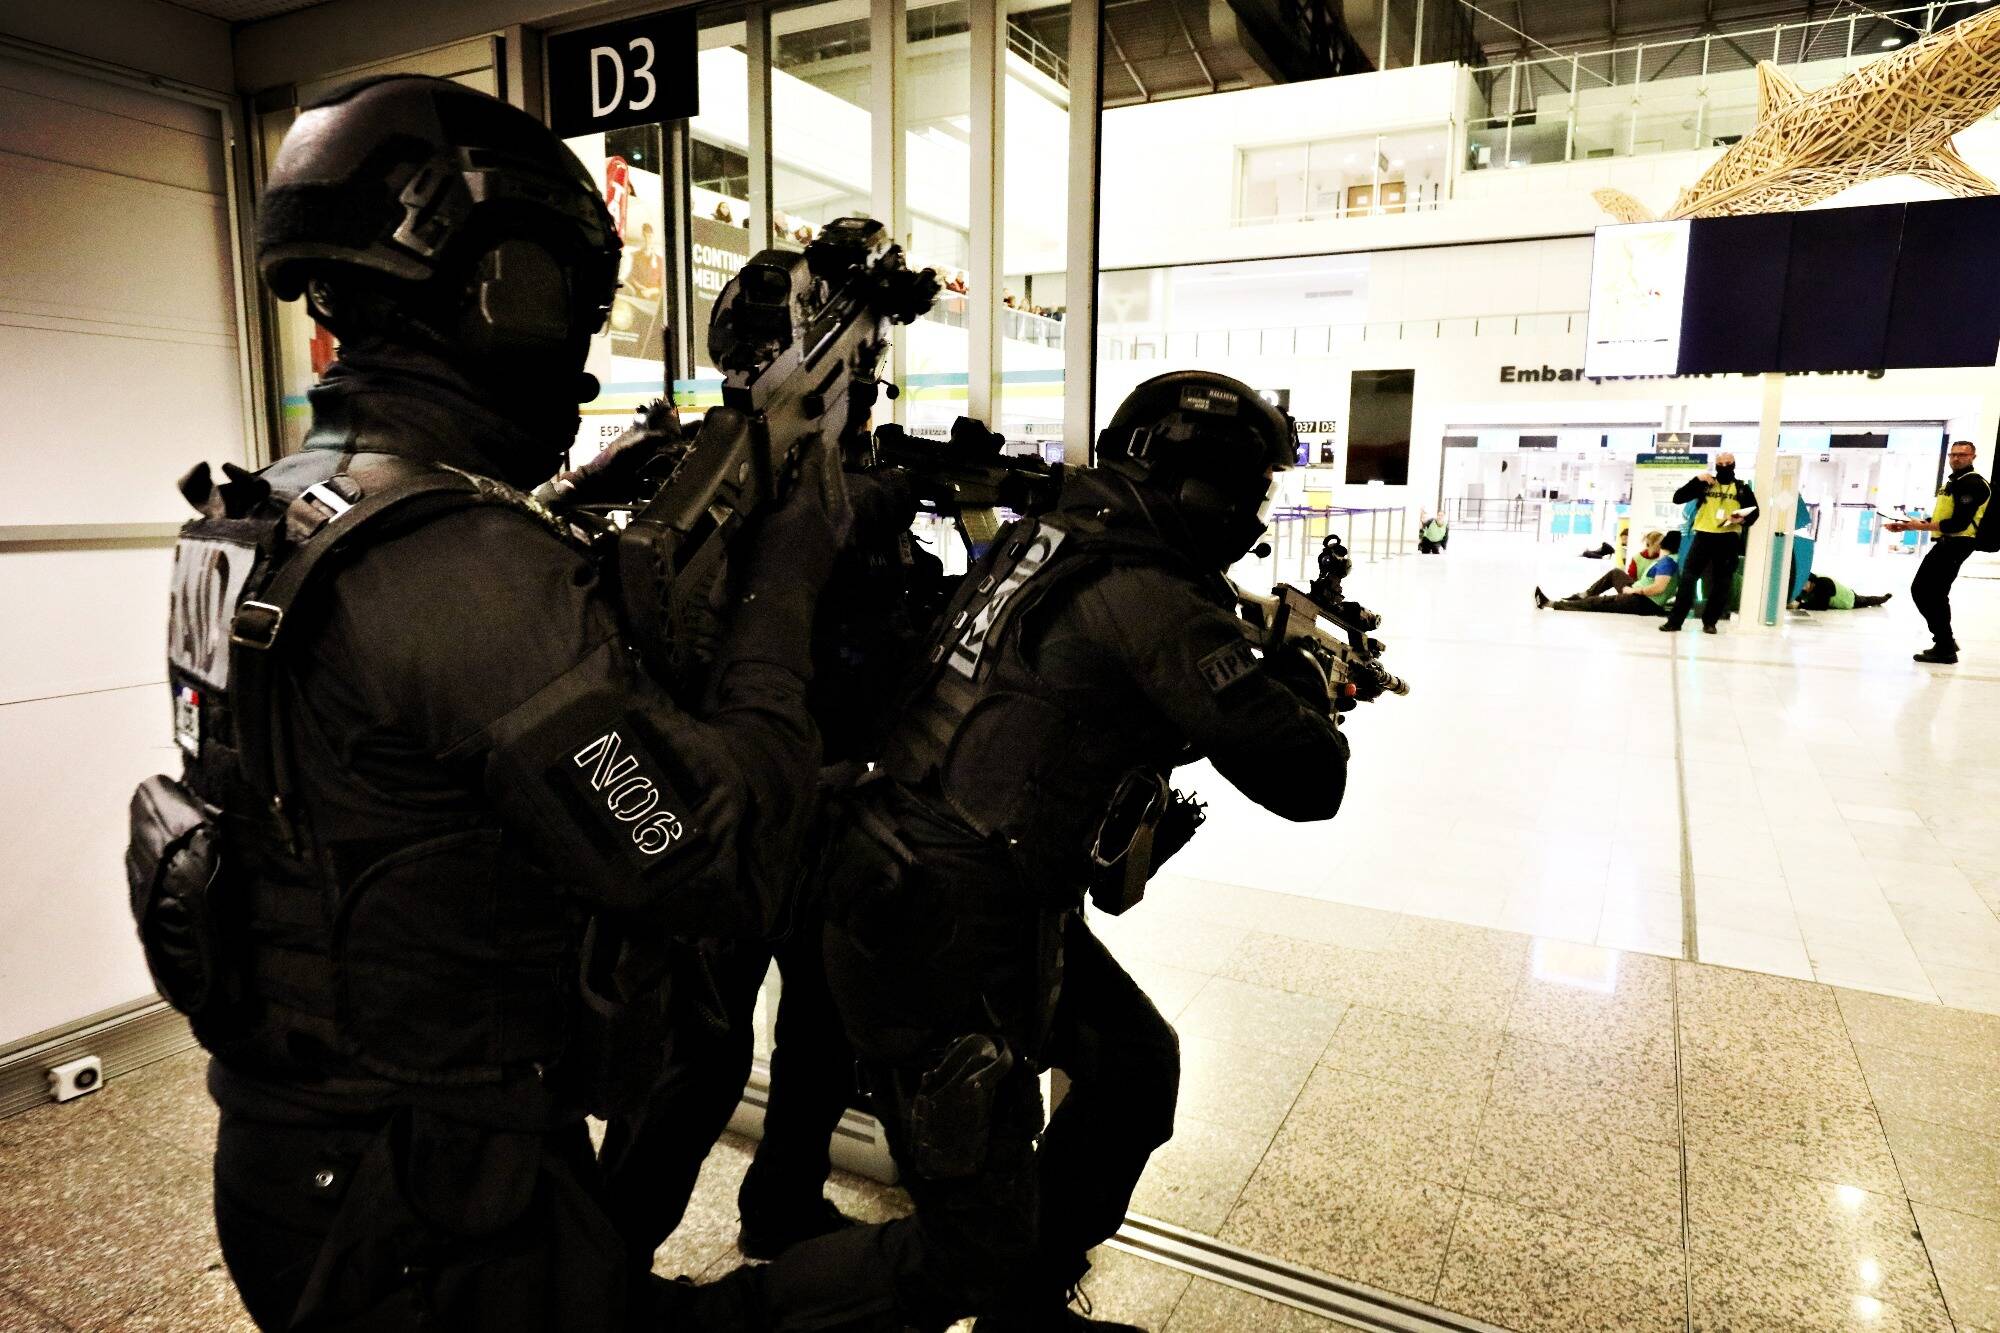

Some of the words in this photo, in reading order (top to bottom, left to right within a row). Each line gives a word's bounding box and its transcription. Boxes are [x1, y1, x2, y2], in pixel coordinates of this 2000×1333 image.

[590, 37, 657, 118] D3
[692, 243, 751, 273] CONTIN
[1295, 421, 1315, 432] D37
[950, 533, 1052, 665] RAID
[573, 730, 683, 855] N06
